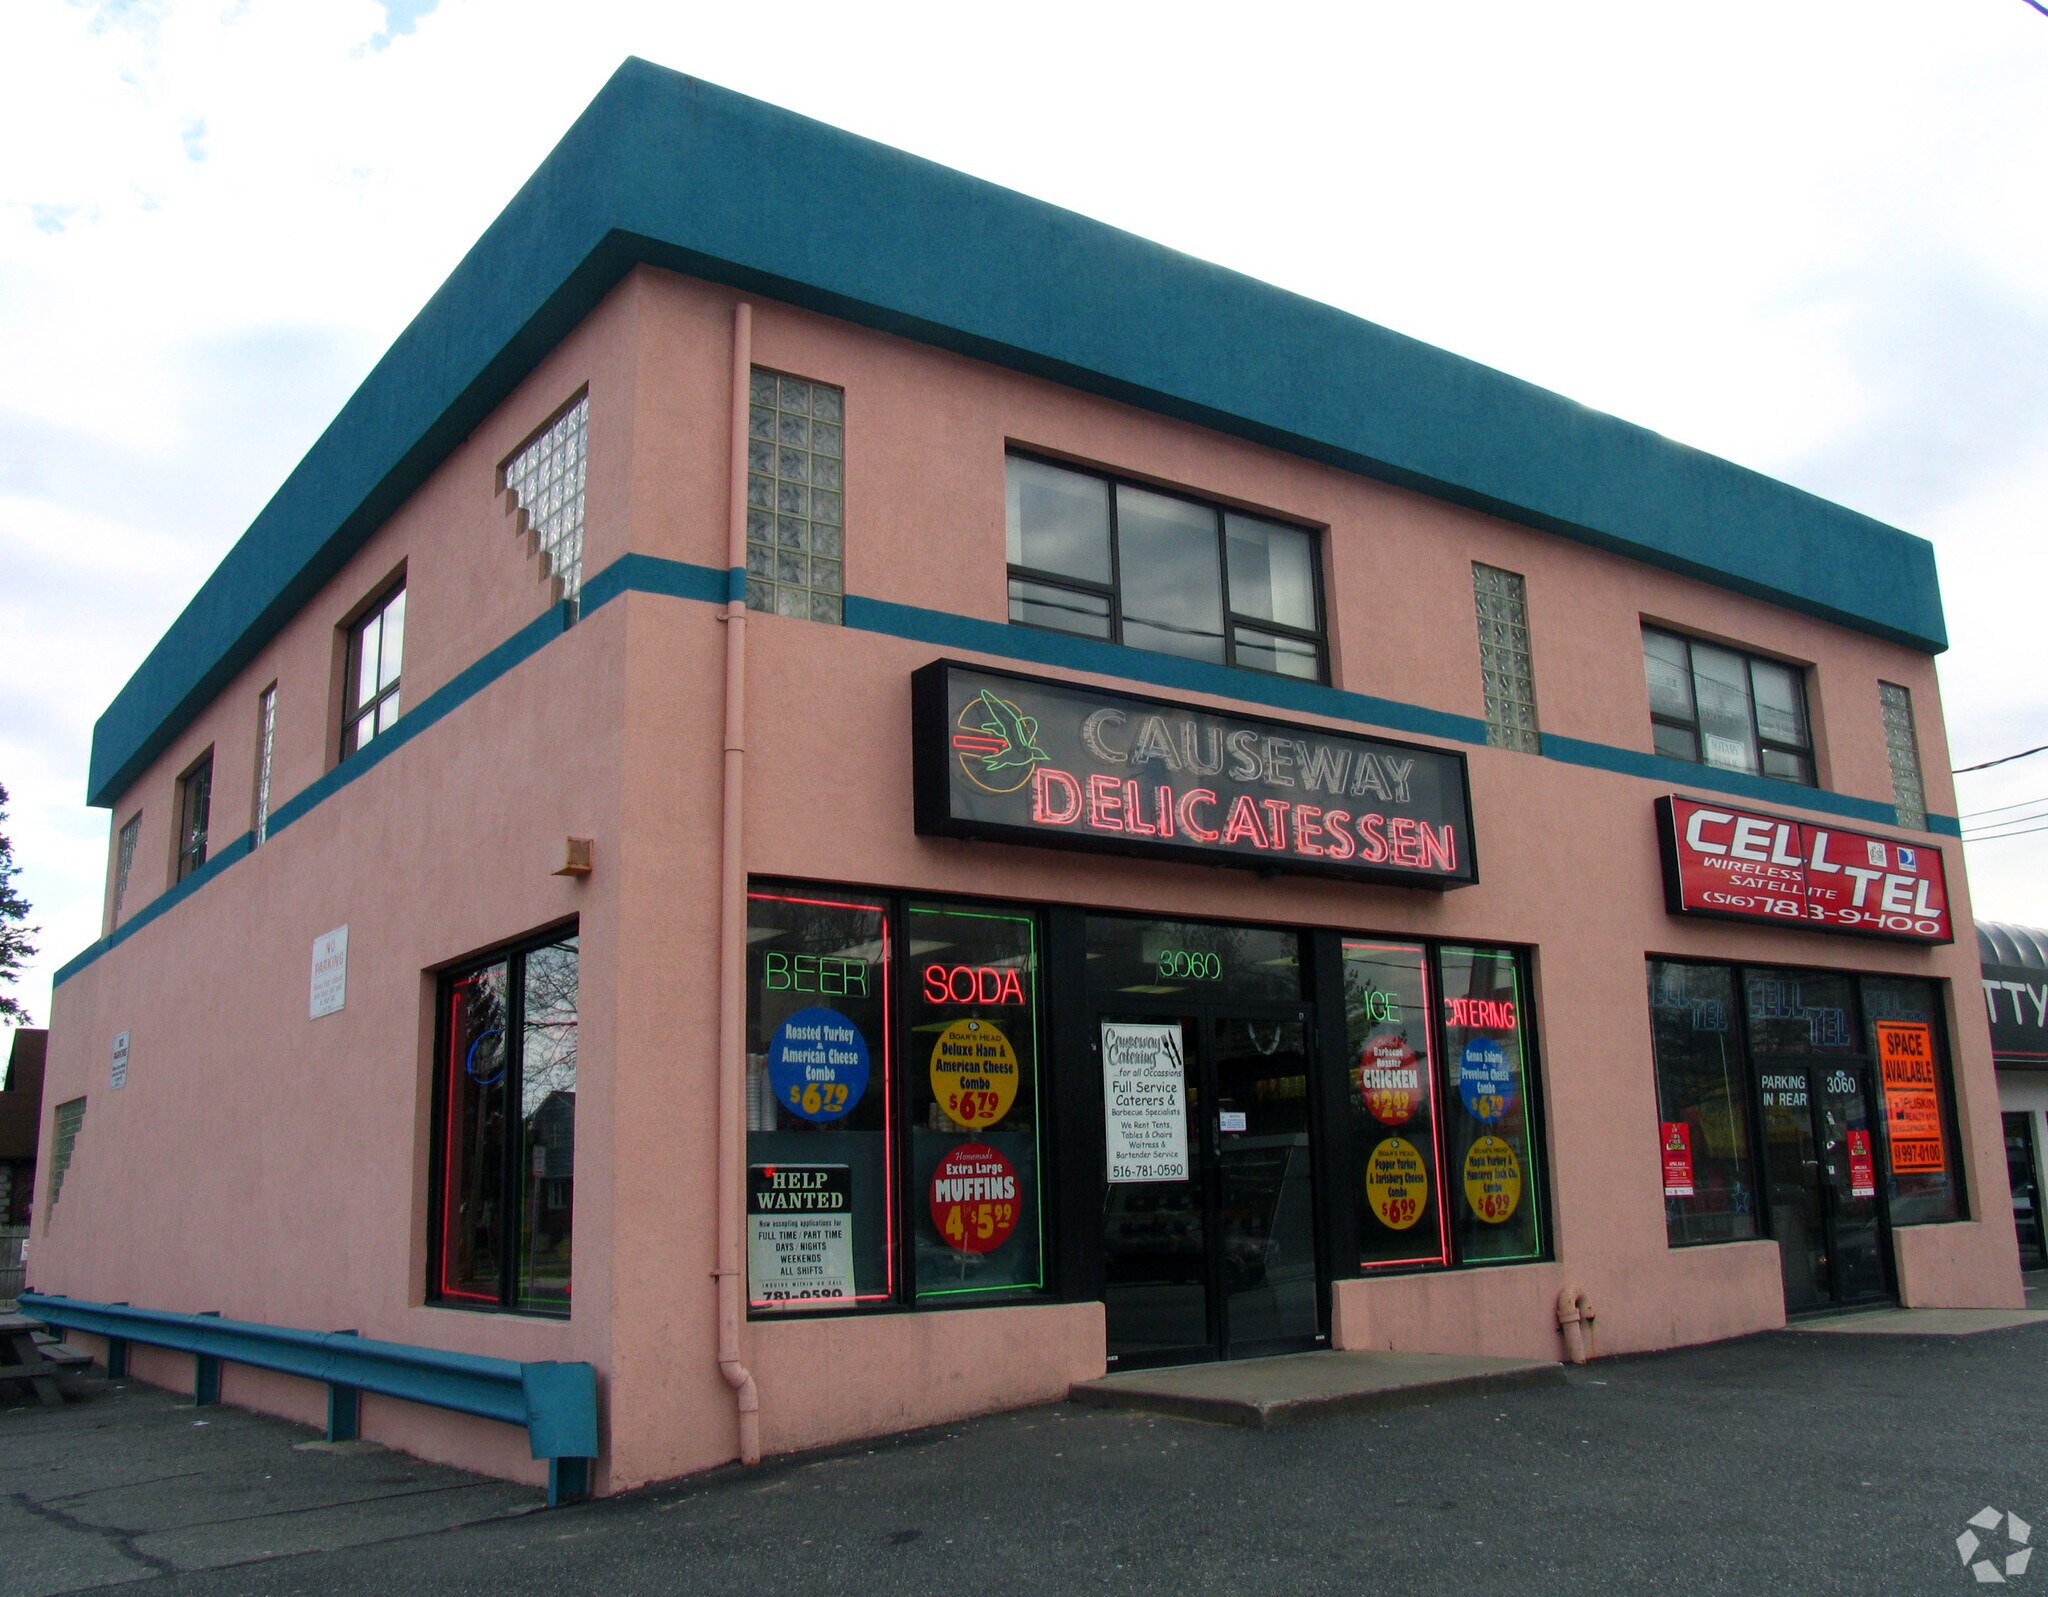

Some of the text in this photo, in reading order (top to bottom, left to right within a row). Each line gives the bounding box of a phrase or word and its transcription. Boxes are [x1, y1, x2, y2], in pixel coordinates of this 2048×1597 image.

[1080, 707, 1415, 803] CAUSEWAY
[1032, 767, 1457, 871] DELICATESSEN
[1685, 809, 1841, 873] CELL
[1703, 857, 1803, 881] WIRELESS
[1729, 875, 1838, 899] SATELLITE
[1844, 866, 1942, 918] TEL
[324, 939, 336, 954] NO
[314, 951, 344, 976] PARKING
[1159, 949, 1221, 979] 3060
[766, 952, 867, 996] BEER
[924, 965, 1025, 1005] SODA
[1364, 990, 1400, 1023] ICE
[1444, 998, 1516, 1029] CATERING
[785, 1023, 855, 1045] Roasted Turkey
[1806, 1007, 1851, 1046] TEL
[979, 1033, 1002, 1042] HEAD
[1104, 1028, 1161, 1054] Causeway
[1886, 1032, 1923, 1056] SPACE
[782, 1046, 859, 1065] American Cheese
[942, 1042, 1006, 1058] Deluxe Ham &
[1107, 1043, 1157, 1070] Catering
[1484, 1050, 1503, 1063] Salami
[805, 1064, 836, 1081] Combo
[936, 1058, 1014, 1074] American Cheese
[1132, 1068, 1142, 1077] all
[1143, 1068, 1182, 1078] Occassions
[1885, 1059, 1933, 1083] AVAILABLE
[1363, 1069, 1418, 1088] CHICKEN
[1490, 1068, 1510, 1081] Cheese
[1761, 1075, 1806, 1090] PARKING
[960, 1076, 990, 1090] Combo
[1112, 1080, 1178, 1093] Full Service
[1477, 1081, 1496, 1094] Combo
[1826, 1076, 1856, 1094] 3060
[1116, 1094, 1175, 1106] Caterers &
[1763, 1092, 1807, 1106] IN REAR
[1111, 1108, 1181, 1117] Barbecue Specialists
[1120, 1121, 1132, 1129] We
[1133, 1121, 1149, 1129] Rent
[1121, 1131, 1173, 1139] Tables & Chairs
[1128, 1141, 1159, 1149] Waitress
[1901, 1143, 1940, 1162] 997-0100
[1116, 1150, 1179, 1159] Bartender Service
[946, 1162, 1003, 1175] Extra Large
[1113, 1163, 1183, 1178] 516-781-0590
[1397, 1158, 1416, 1171] Turkey
[772, 1172, 828, 1189] HELP
[1404, 1172, 1425, 1183] Cheese
[935, 1175, 1015, 1203] MUFFINS
[1388, 1186, 1407, 1198] Combo
[756, 1192, 844, 1209] WANTED
[772, 1220, 798, 1228] accepting
[800, 1220, 832, 1228] applications
[945, 1205, 964, 1240] 4
[758, 1231, 776, 1240] FULL
[825, 1230, 842, 1239] TIME
[780, 1254, 822, 1263] WEEKENDS
[780, 1266, 824, 1275] ALL SHIFTS
